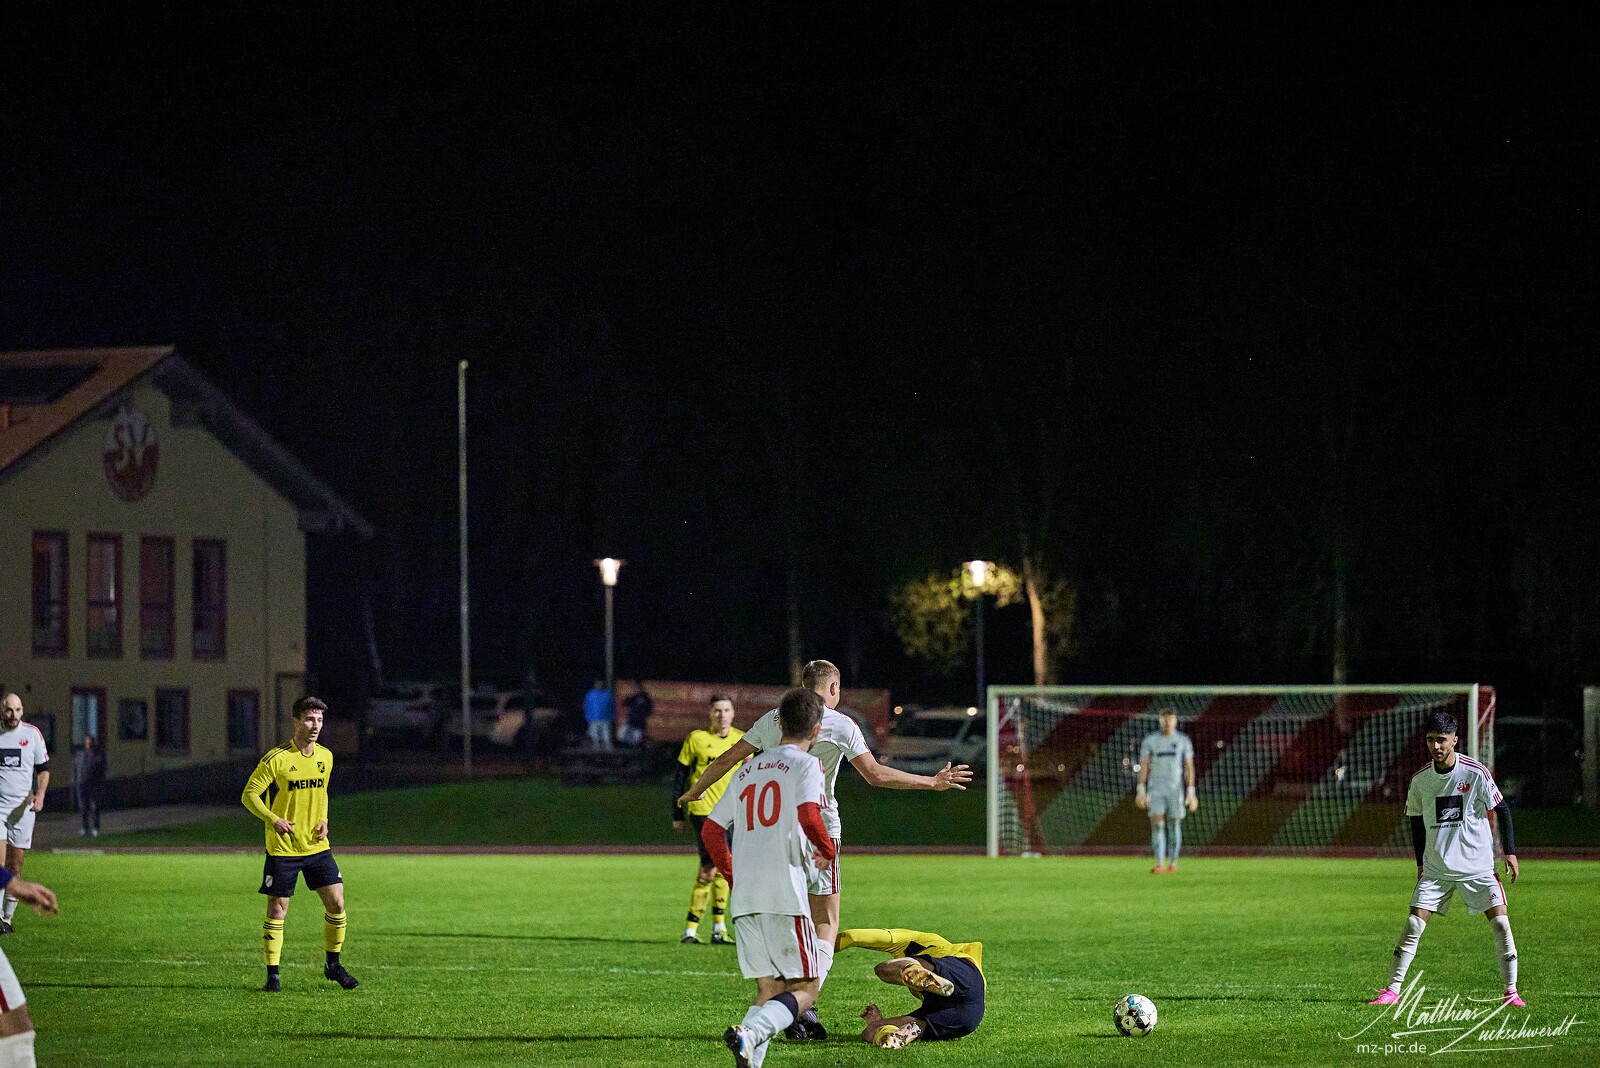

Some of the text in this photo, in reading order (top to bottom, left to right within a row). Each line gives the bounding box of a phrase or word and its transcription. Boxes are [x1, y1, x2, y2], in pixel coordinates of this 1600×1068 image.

[739, 760, 790, 781] SV Laufen
[288, 778, 325, 791] MEIND
[739, 780, 782, 832] 10
